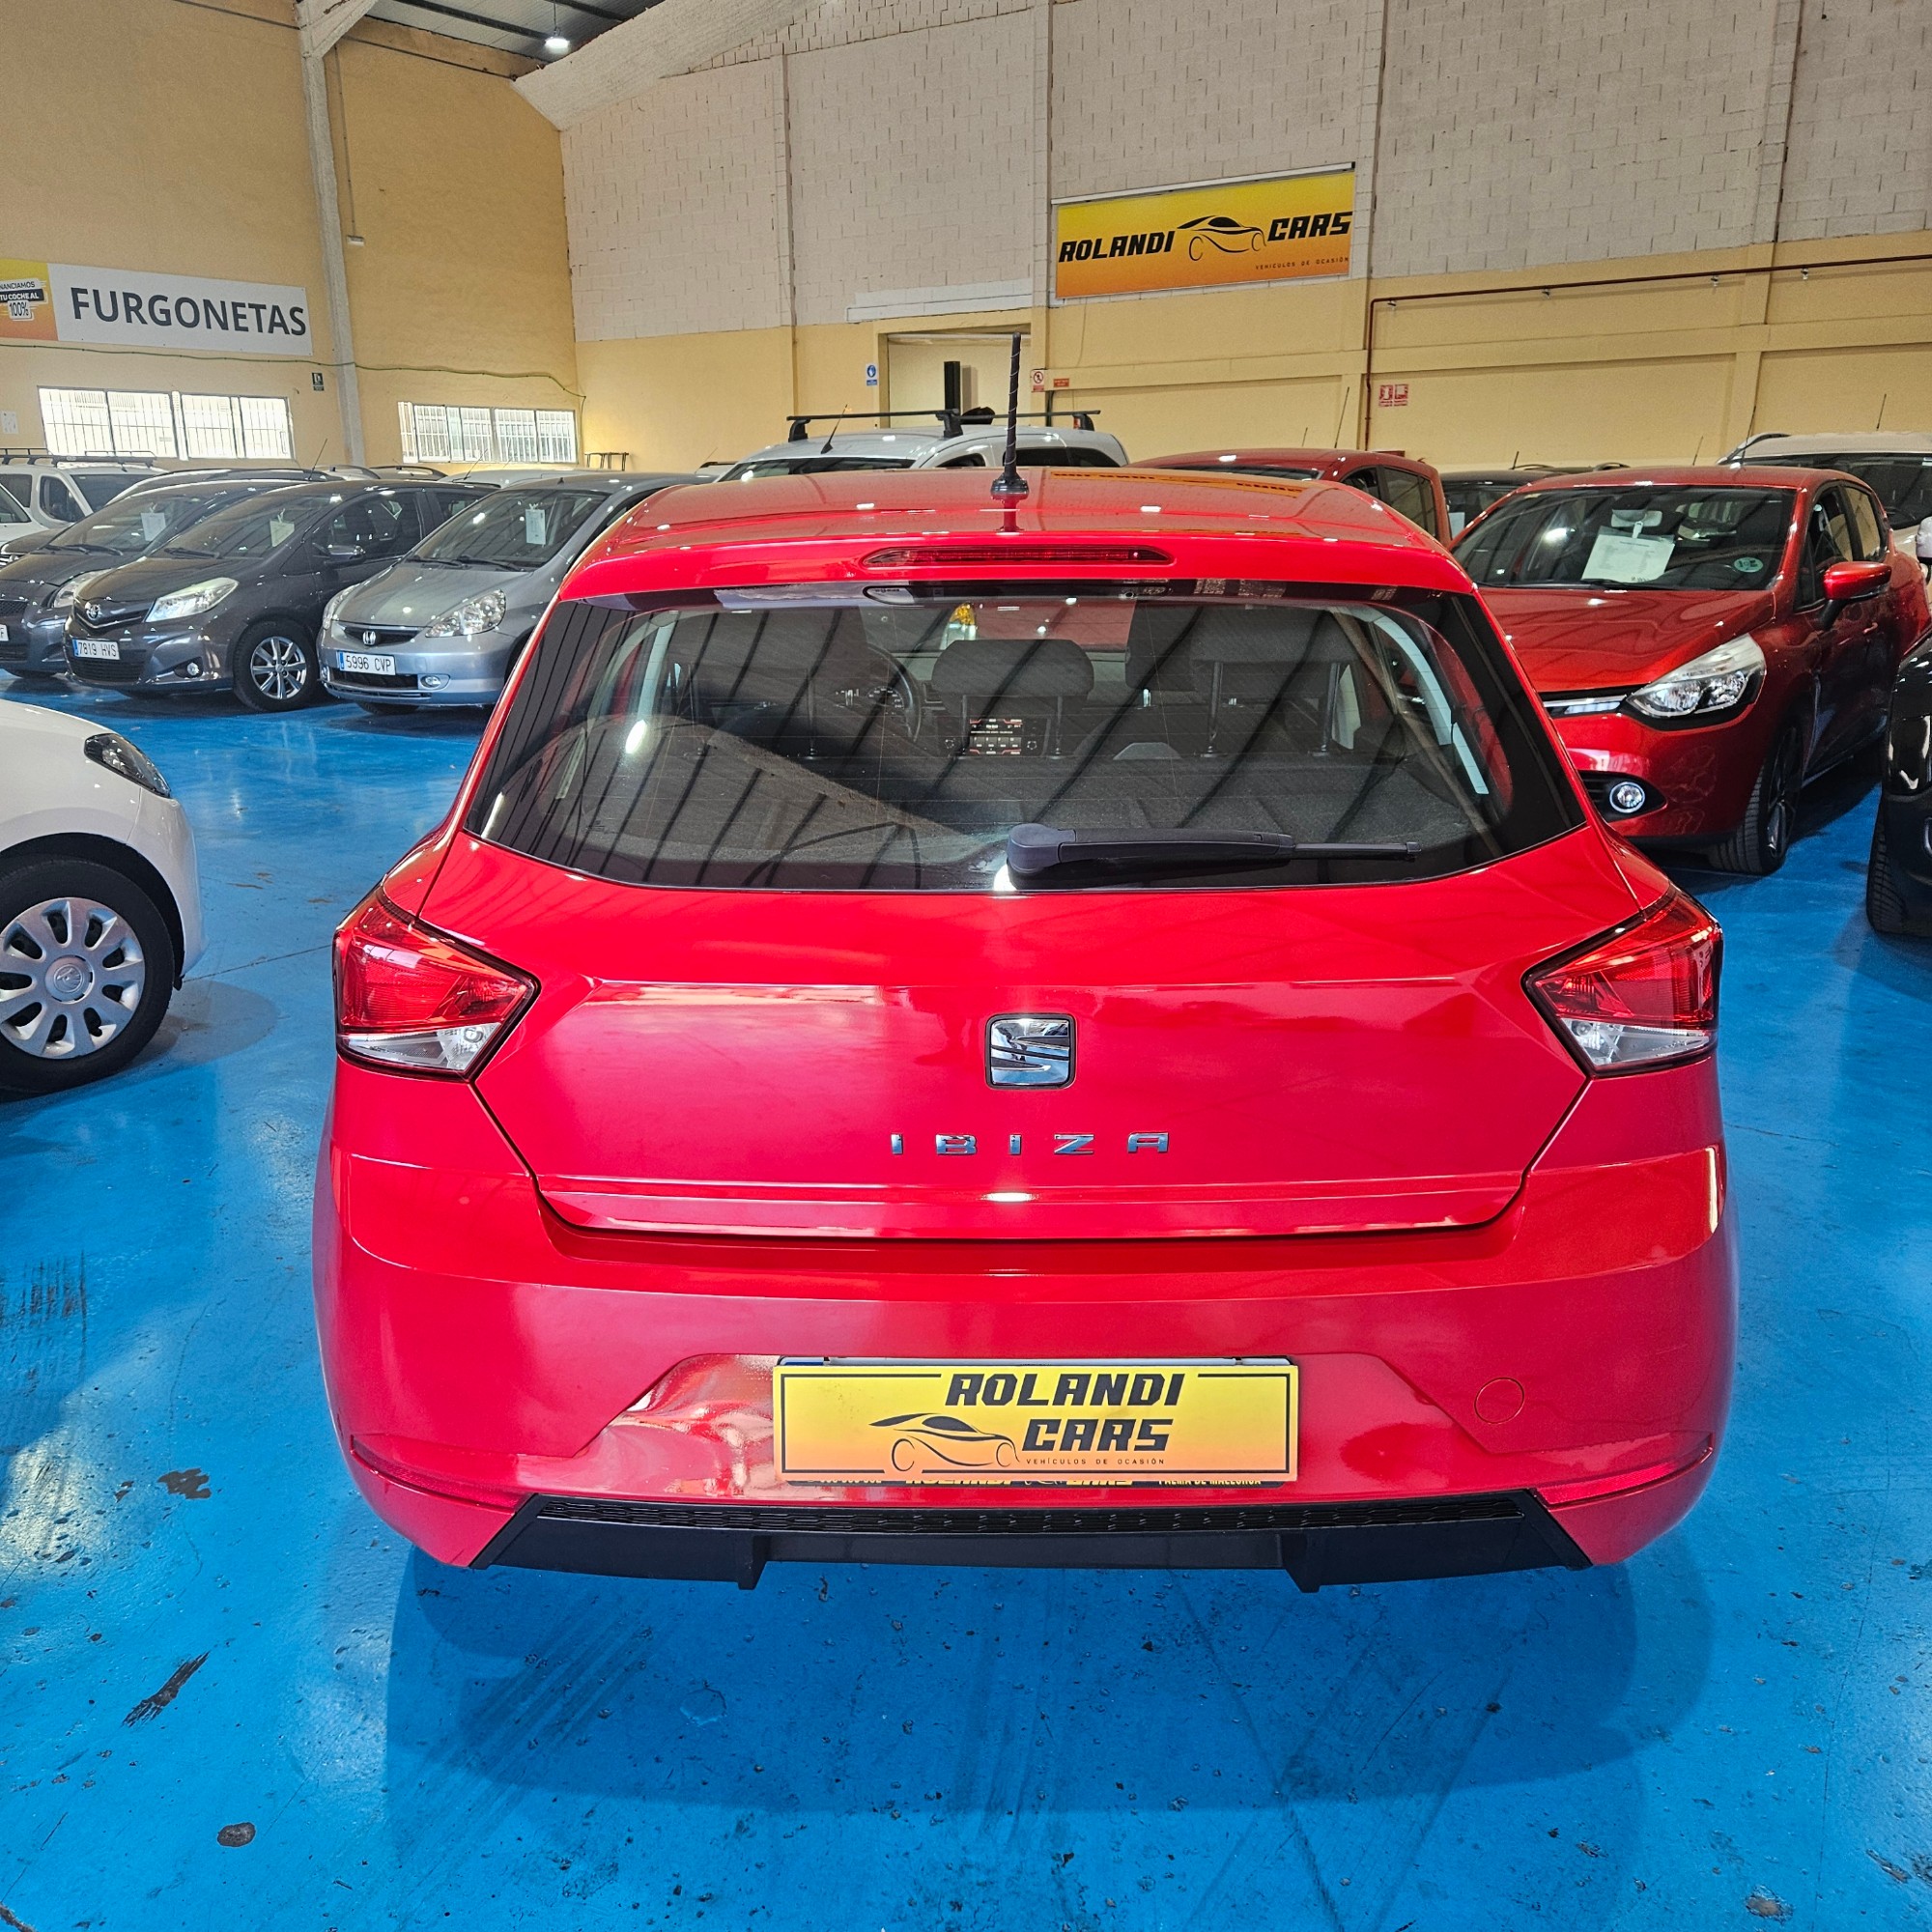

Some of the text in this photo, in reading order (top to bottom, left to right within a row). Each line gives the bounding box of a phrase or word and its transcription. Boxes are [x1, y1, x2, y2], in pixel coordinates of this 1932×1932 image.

[1059, 211, 1353, 263] ROLANDI CARS
[10, 301, 29, 317] 100%
[71, 287, 306, 335] FURGONETAS
[77, 641, 117, 657] 7819 HVS
[346, 655, 391, 672] 5996 CVP
[891, 1132, 1169, 1155] IBIZA
[945, 1373, 1185, 1406] ROLANDI
[1022, 1418, 1174, 1452] CARS
[1026, 1457, 1087, 1465] VEHÍCULOS
[1117, 1457, 1165, 1465] OCASIÓN
